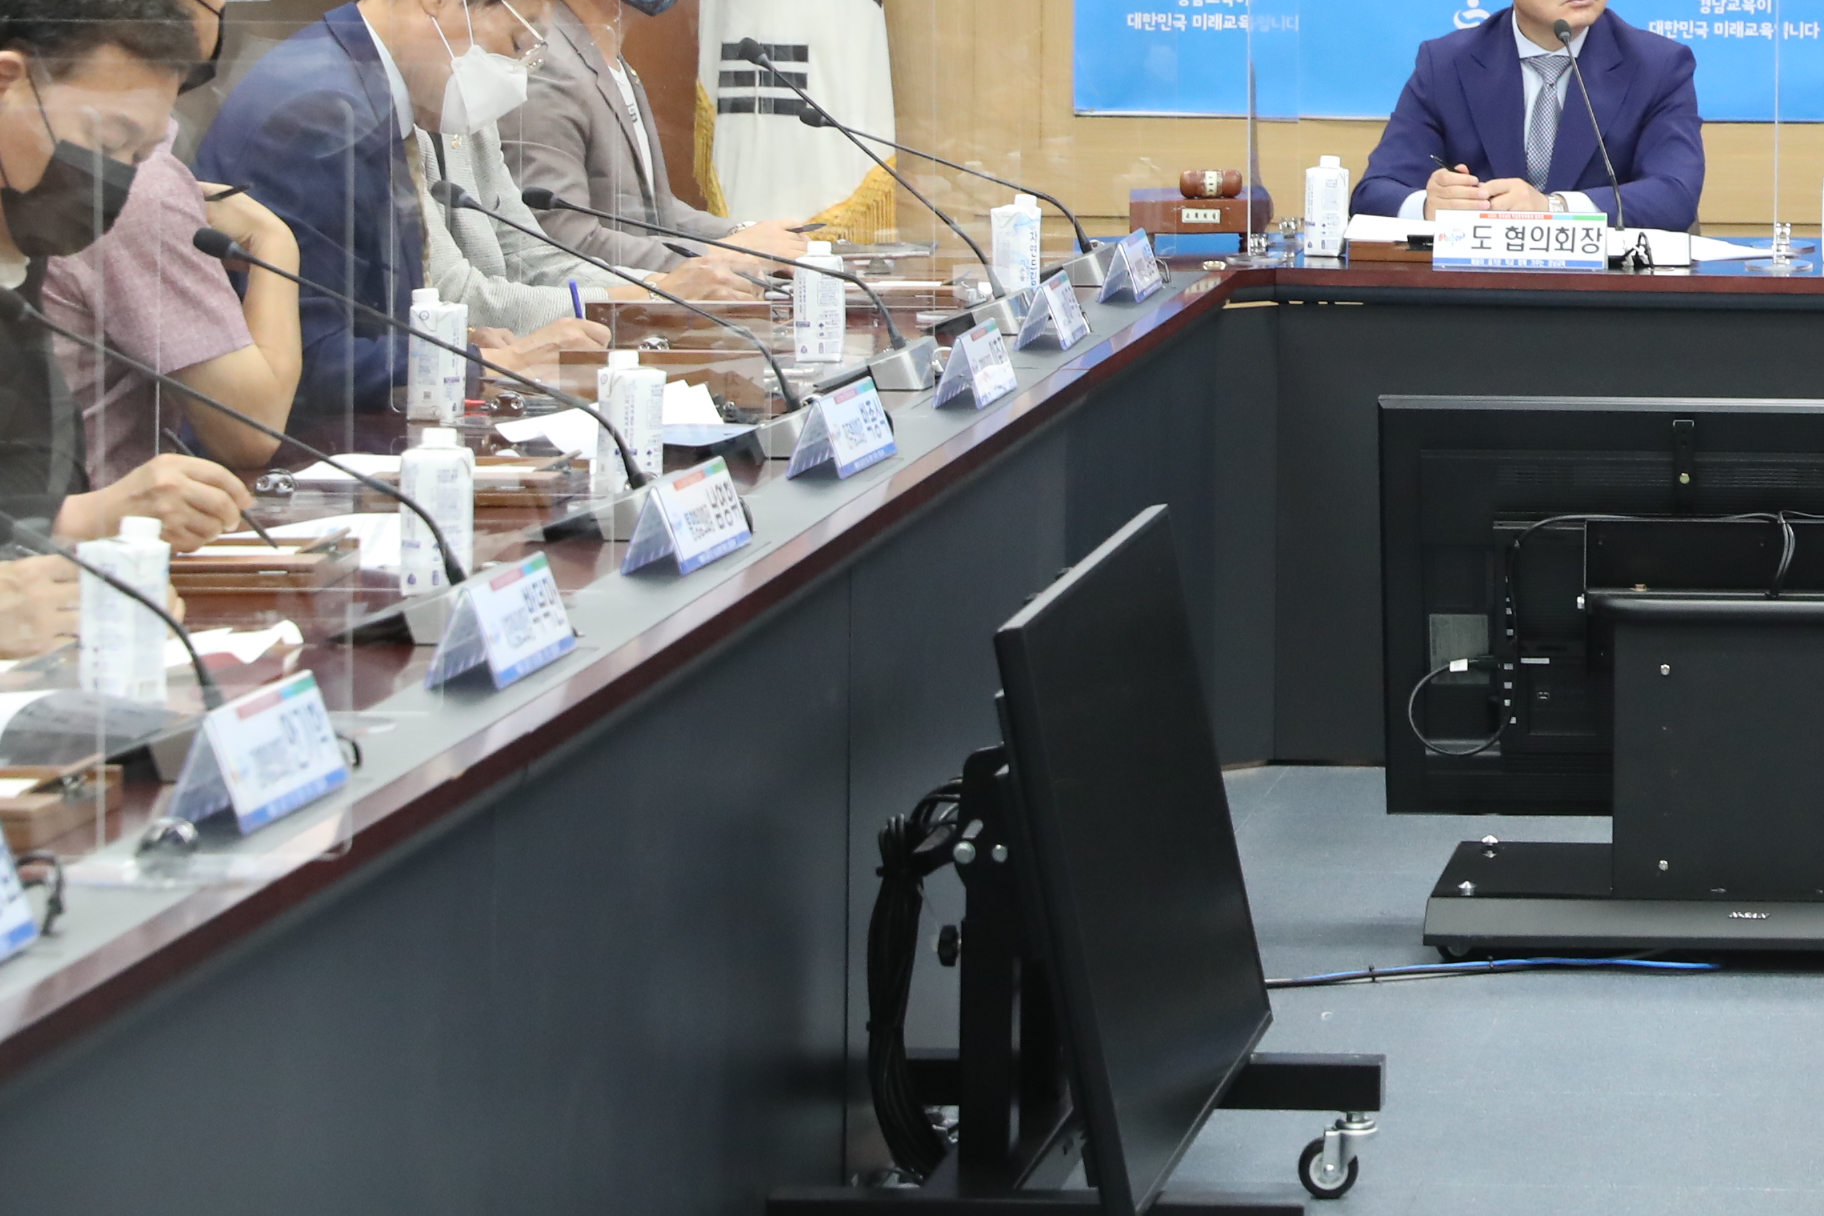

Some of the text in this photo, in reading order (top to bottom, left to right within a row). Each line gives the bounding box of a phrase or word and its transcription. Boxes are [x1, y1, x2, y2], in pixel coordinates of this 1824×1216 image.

[1126, 12, 1188, 31] 대한민국
[1471, 225, 1603, 254] 도 협의회장
